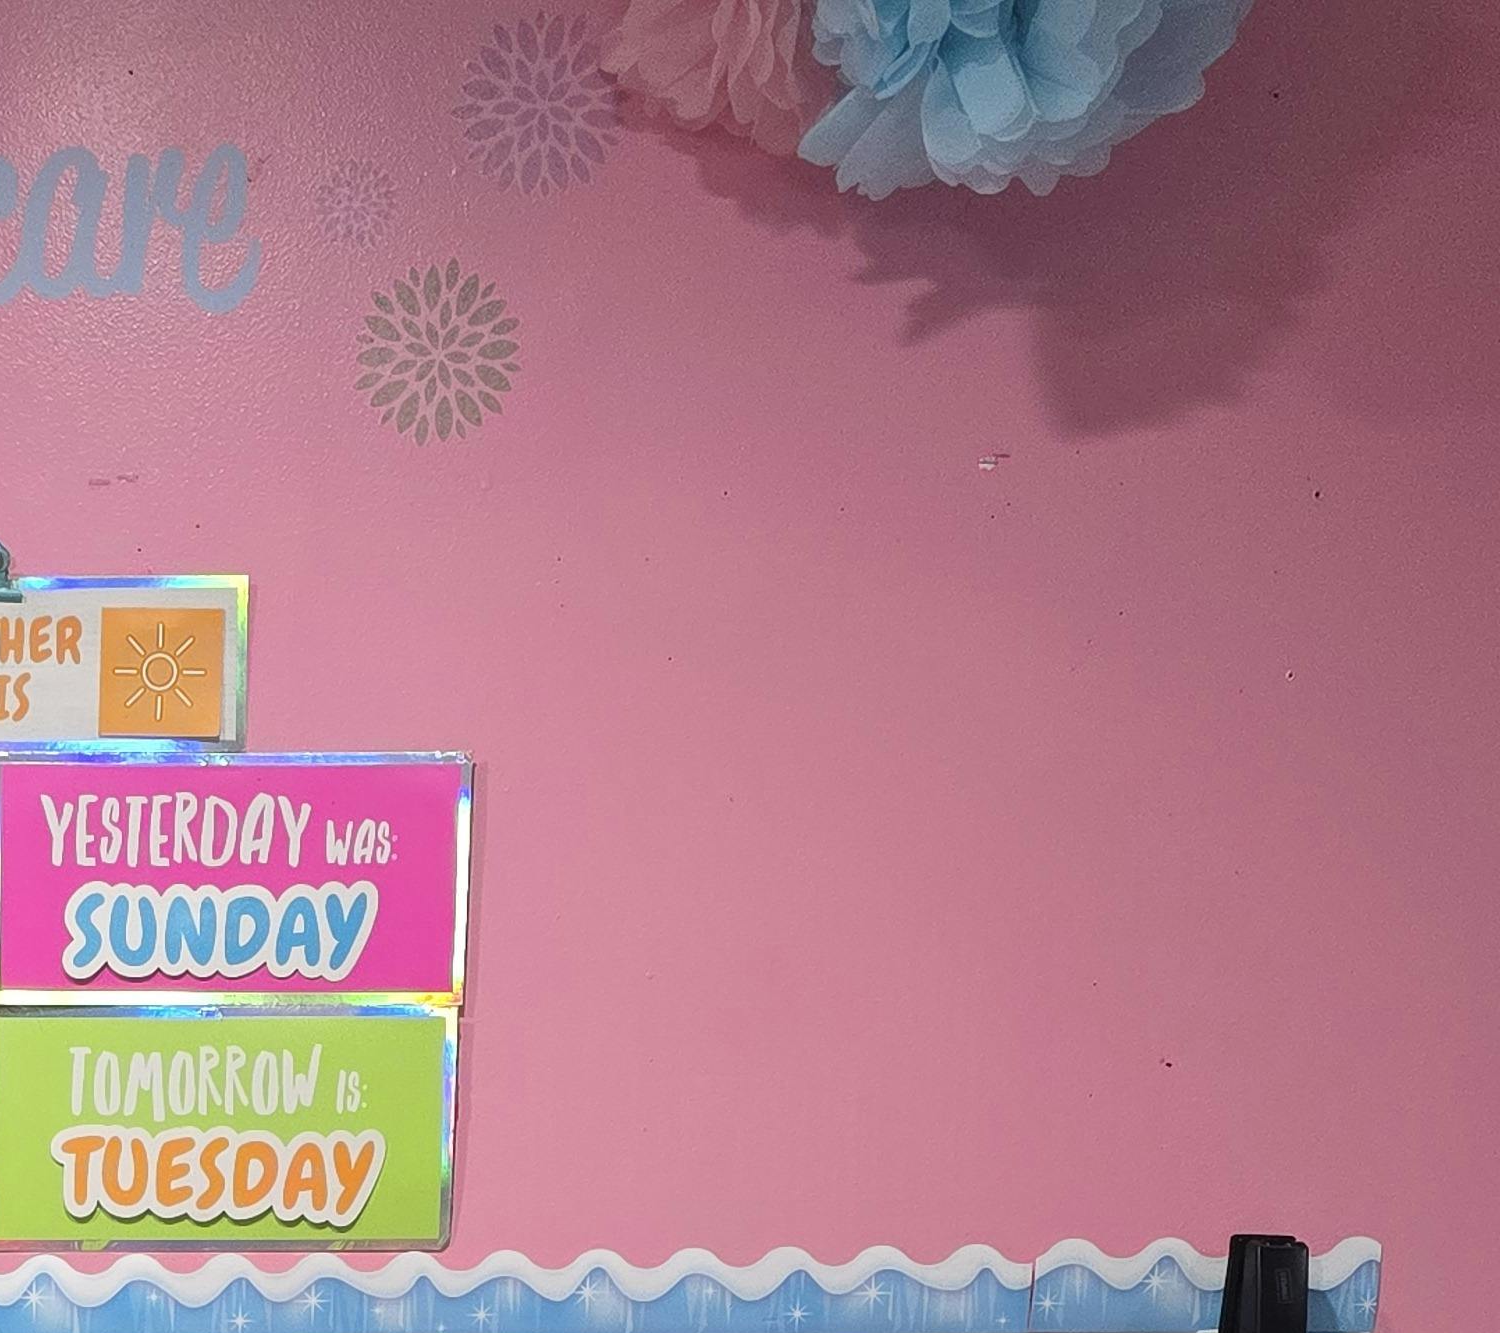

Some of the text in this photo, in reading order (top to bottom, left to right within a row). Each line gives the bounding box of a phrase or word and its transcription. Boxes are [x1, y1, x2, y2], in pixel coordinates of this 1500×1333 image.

[41, 791, 399, 868] YESTERDAY WAS:
[73, 889, 371, 968] SUNDAY
[67, 1045, 369, 1122] TOMORROW IS:
[61, 1136, 376, 1215] TUESDAY
